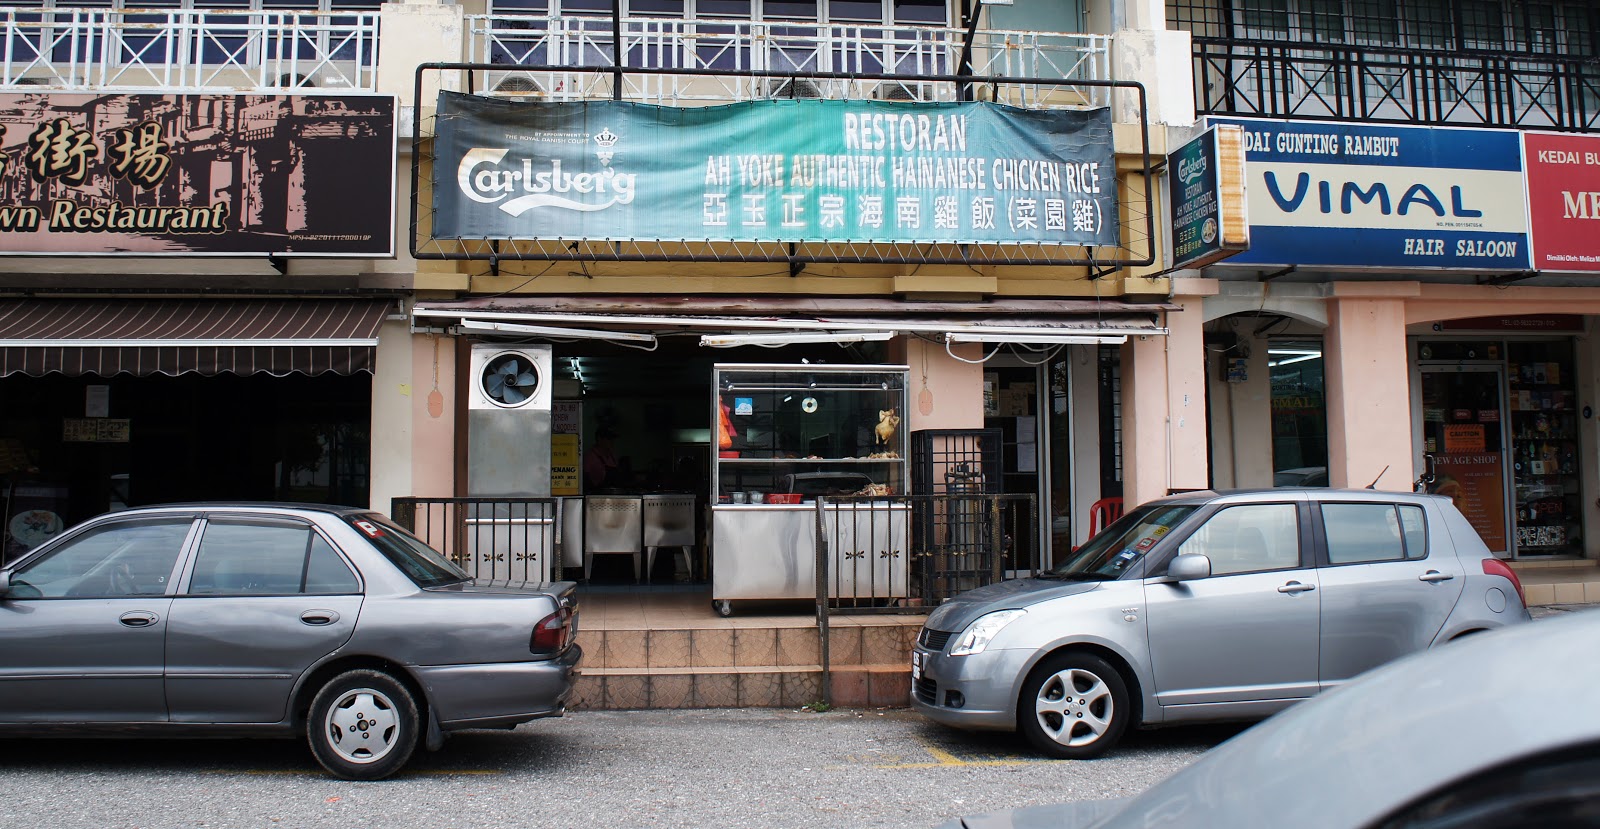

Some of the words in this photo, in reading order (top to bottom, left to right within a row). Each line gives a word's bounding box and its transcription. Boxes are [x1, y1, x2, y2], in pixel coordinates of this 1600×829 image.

[844, 113, 967, 152] RESTORAN
[1276, 133, 1339, 155] GUNTING
[1345, 136, 1399, 157] RAMBUT
[1178, 155, 1207, 184] Carlsberg
[1538, 150, 1580, 165] KEDAI
[457, 148, 637, 207] Carlsberg
[705, 155, 731, 186] AH
[736, 154, 784, 187] YOKE
[791, 155, 886, 189] AUTHENTIC
[892, 156, 986, 190] HAINANESE
[992, 159, 1062, 192] CHICKEN
[1065, 163, 1100, 194] RICE
[1263, 171, 1483, 218] VIMAL
[52, 202, 225, 229] Restaurant
[1404, 239, 1445, 255] HAIR
[1455, 241, 1517, 258] SALOON
[1452, 456, 1472, 465] AGE
[1472, 455, 1497, 464] SHOP
